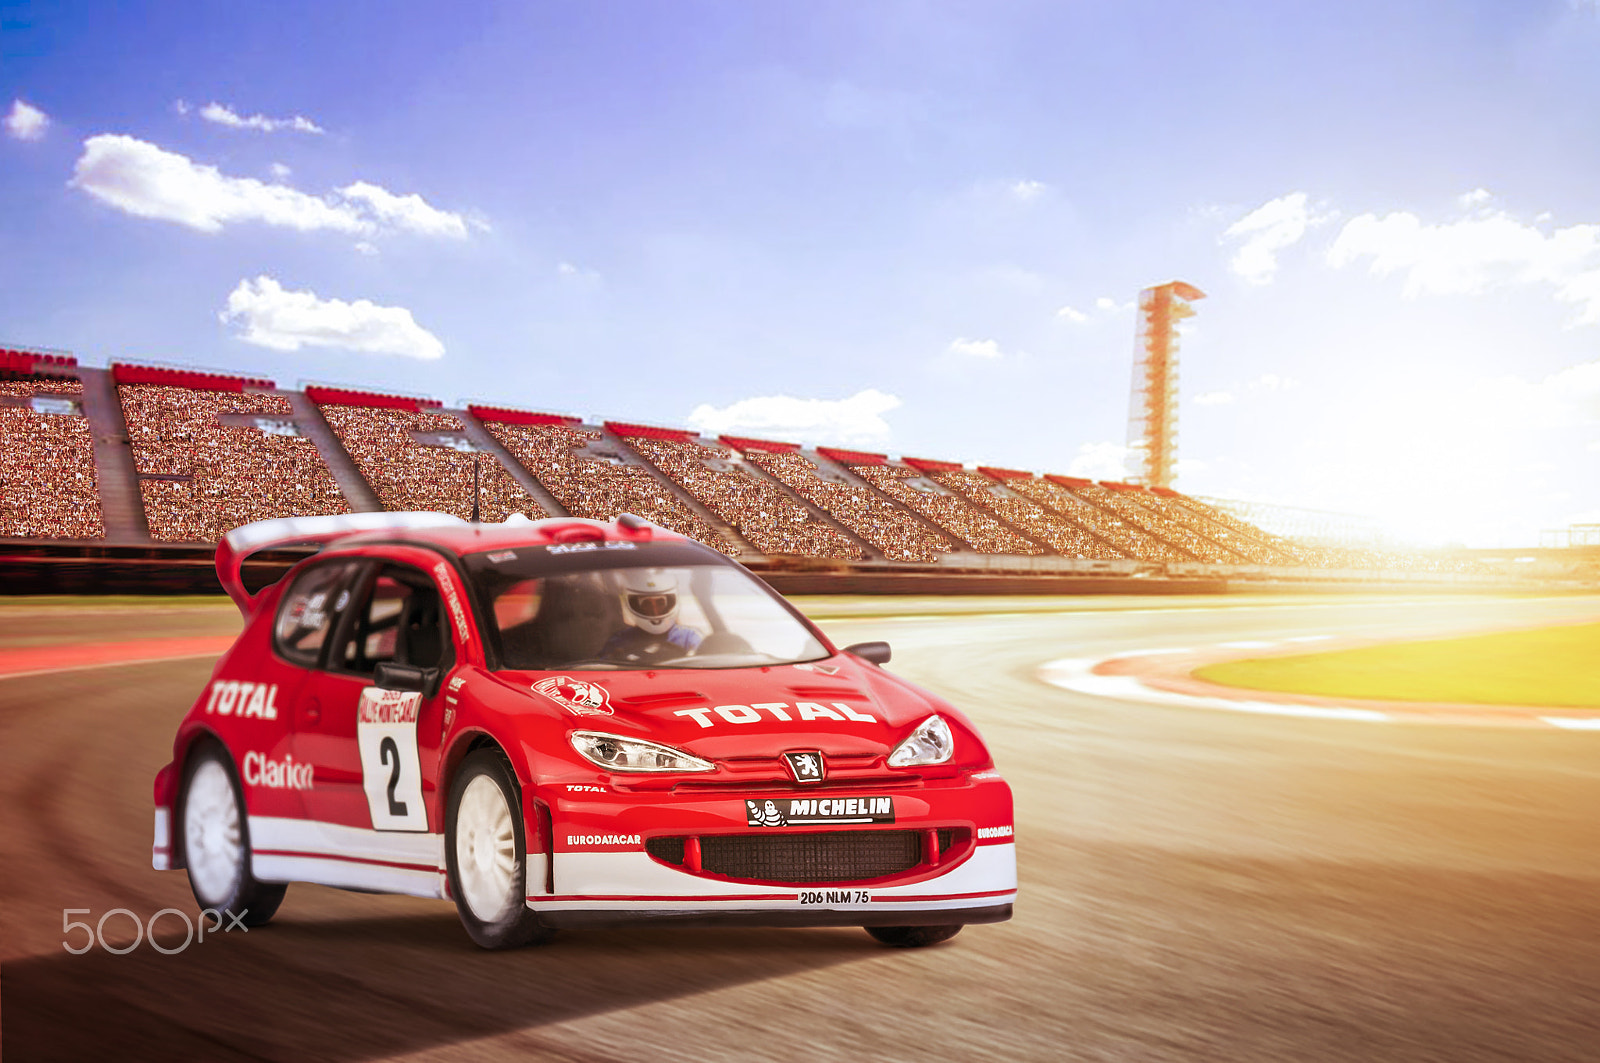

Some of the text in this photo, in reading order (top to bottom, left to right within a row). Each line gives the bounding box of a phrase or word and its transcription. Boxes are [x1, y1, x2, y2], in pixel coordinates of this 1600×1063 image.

[205, 680, 278, 721] TOTAL
[673, 701, 877, 729] TOTAL
[243, 751, 314, 790] Clarion
[379, 736, 409, 817] 2
[566, 785, 607, 793] TOTAL
[789, 797, 891, 816] MICHELIN
[567, 834, 641, 846] EURODATACAR
[800, 891, 870, 905] 206 NLM 75
